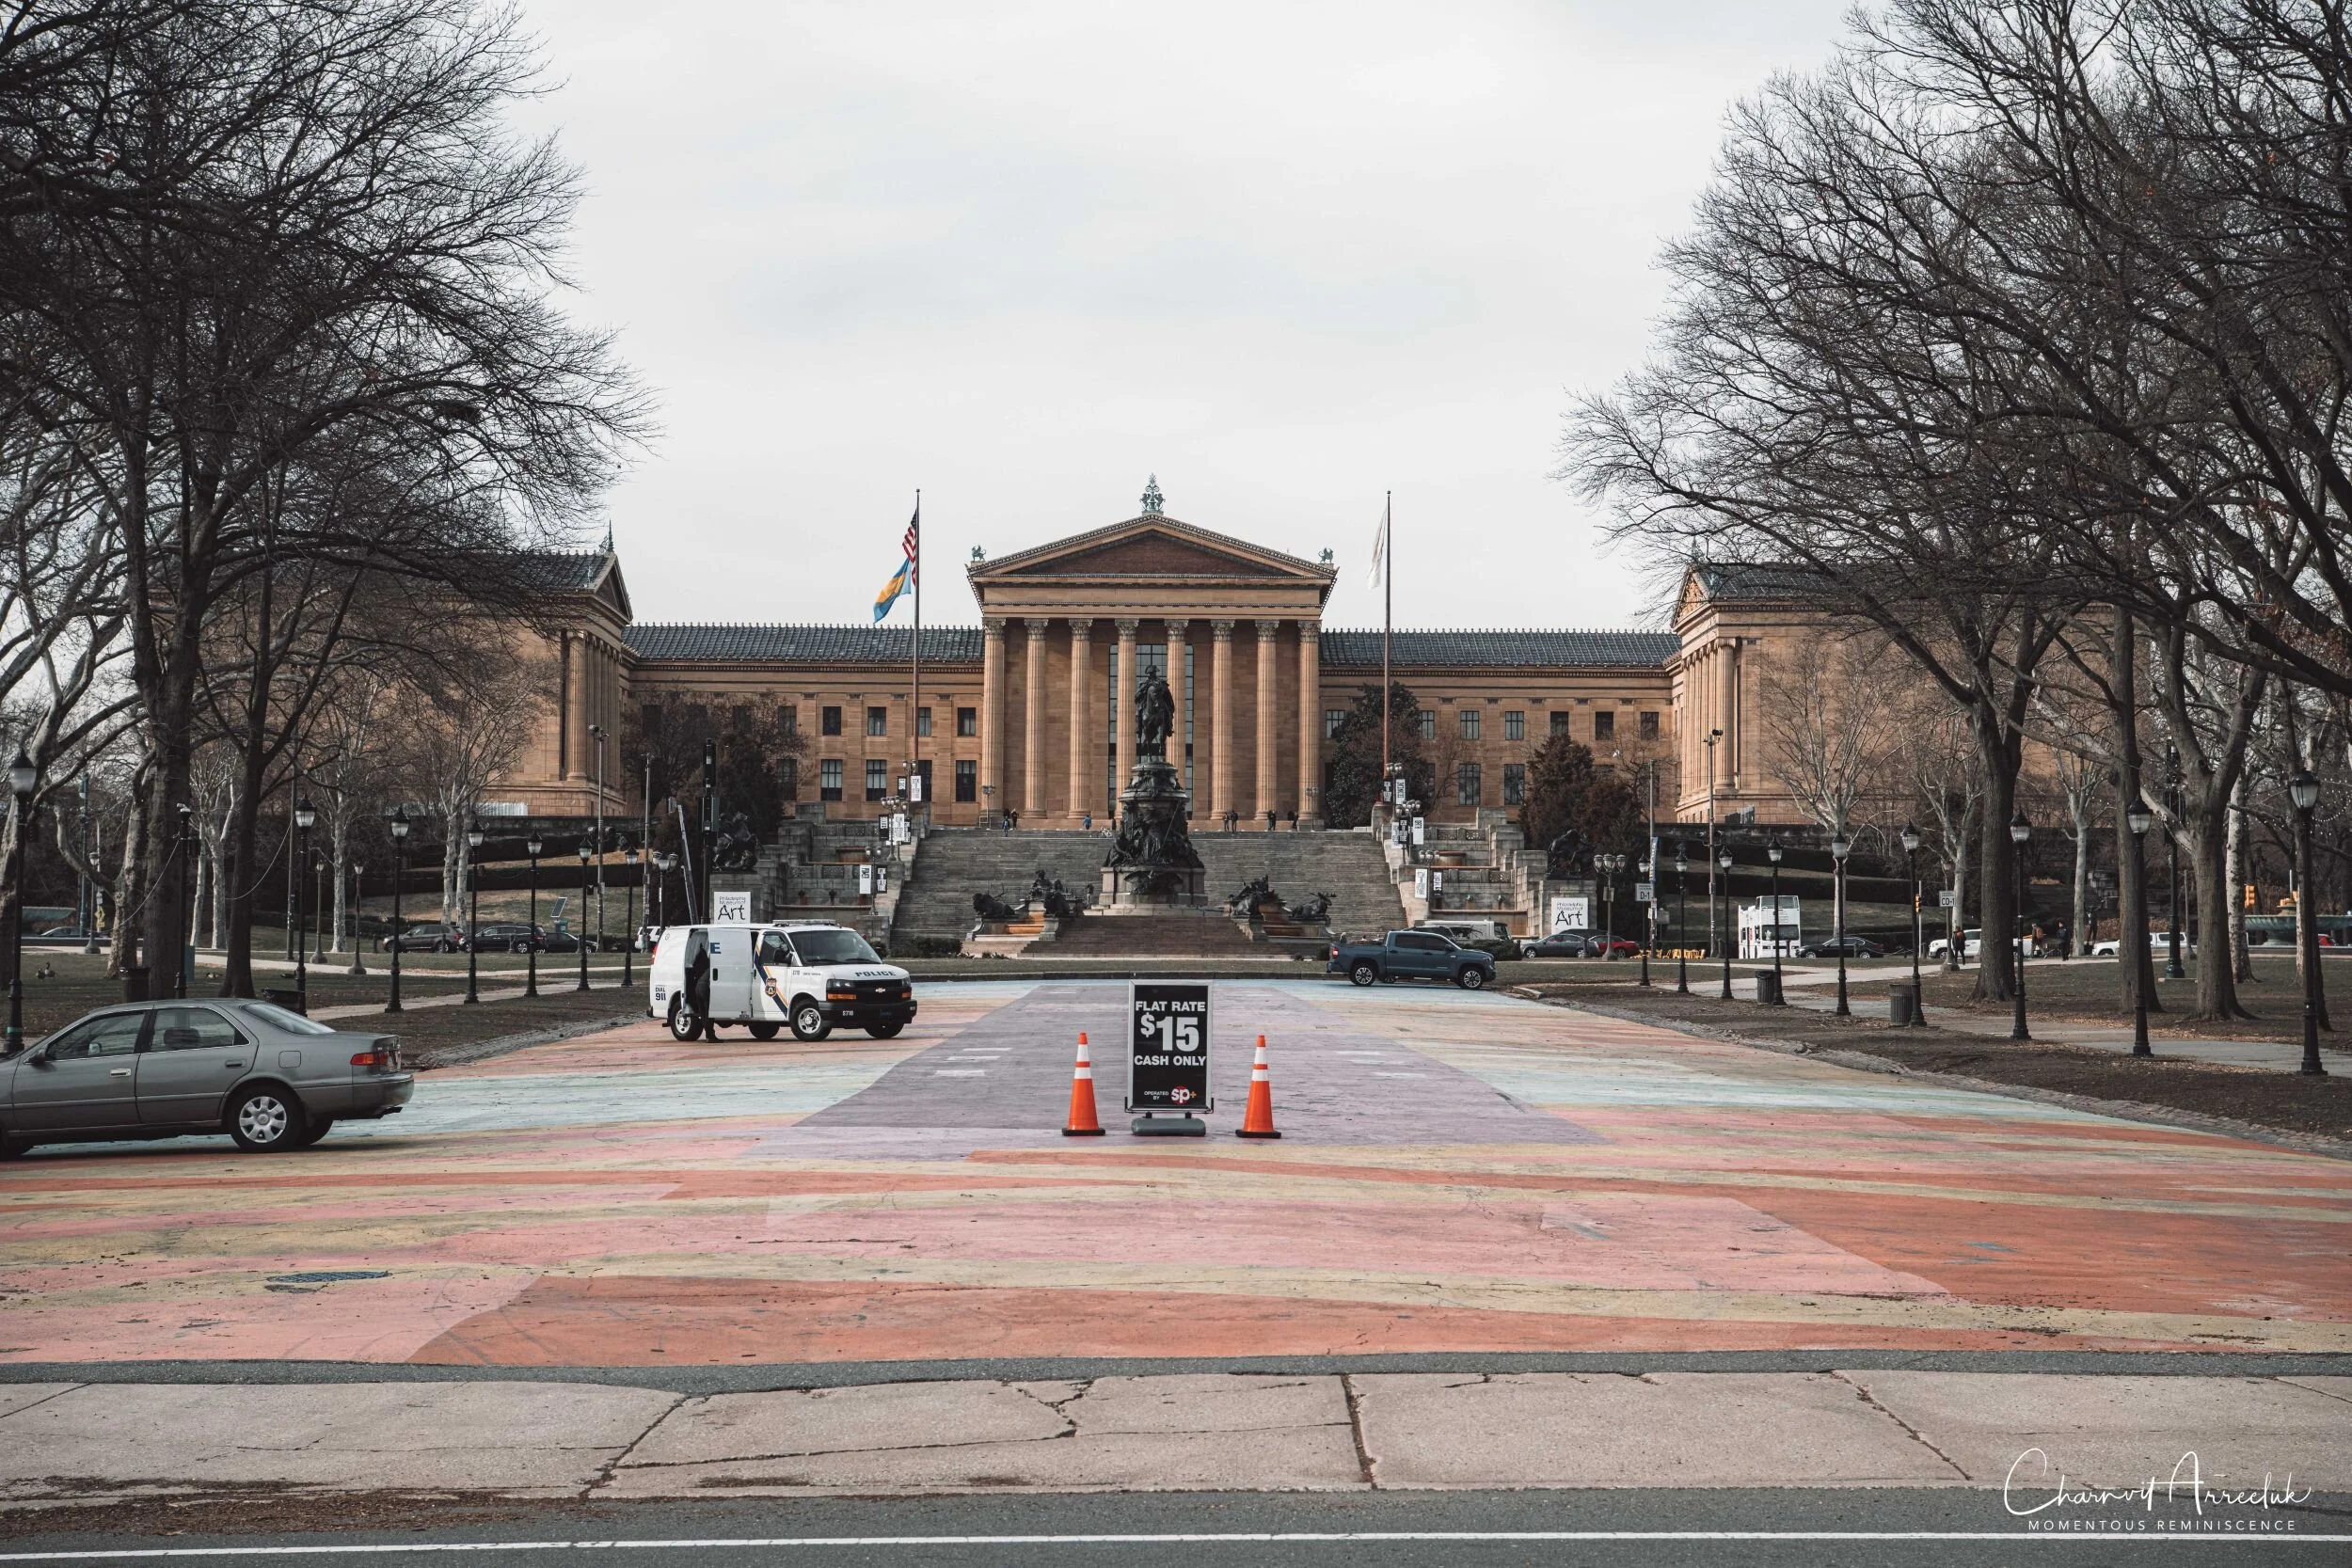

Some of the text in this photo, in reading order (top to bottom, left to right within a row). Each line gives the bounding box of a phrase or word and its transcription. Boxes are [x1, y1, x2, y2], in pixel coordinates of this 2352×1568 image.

[717, 904, 746, 920] Art
[1555, 911, 1583, 927] Art
[710, 942, 721, 954] E
[655, 992, 666, 1001] 911
[1135, 1001, 1206, 1012] FLAT RATE
[1140, 1012, 1200, 1053] $15
[1134, 1054, 1207, 1067] CASH ONLY
